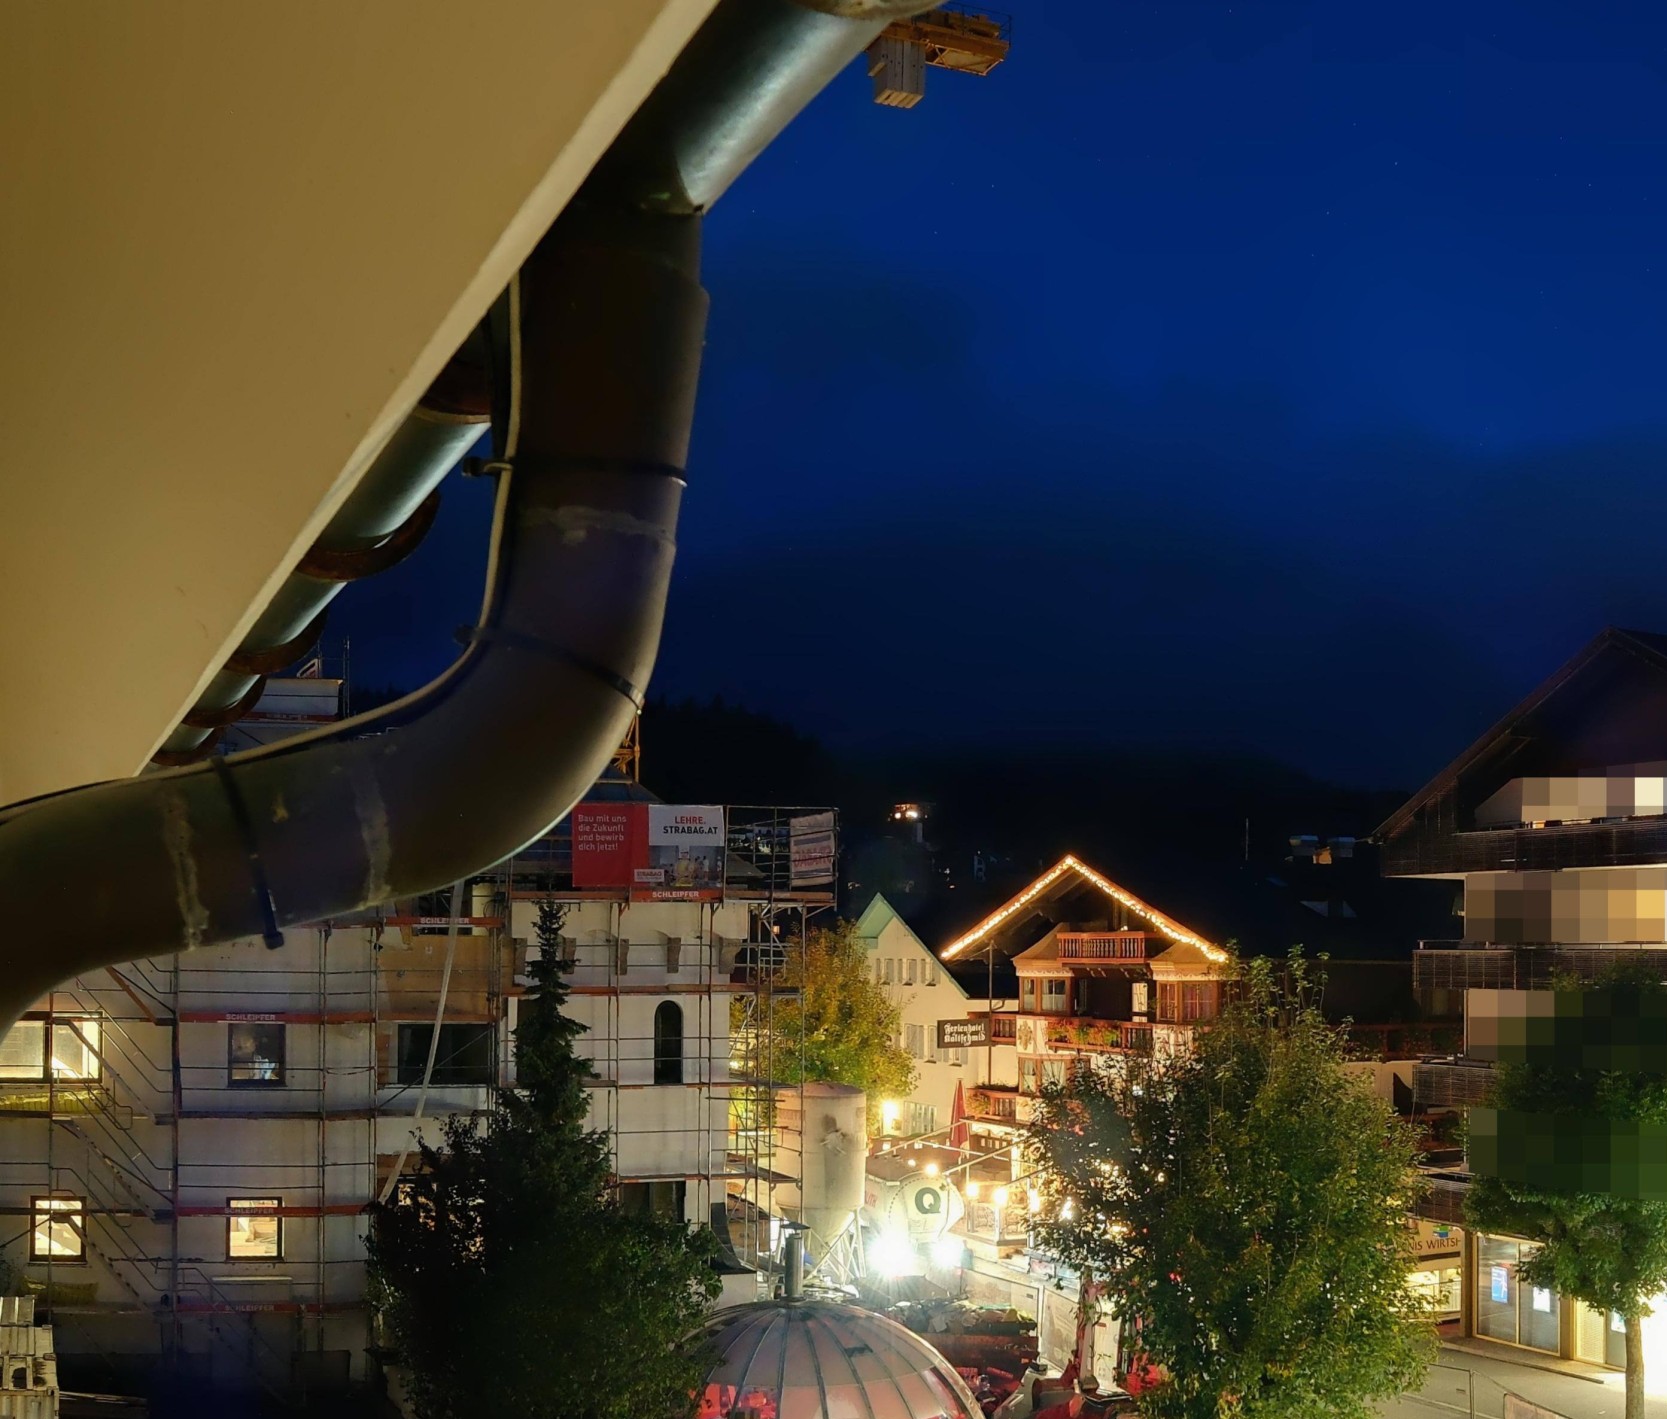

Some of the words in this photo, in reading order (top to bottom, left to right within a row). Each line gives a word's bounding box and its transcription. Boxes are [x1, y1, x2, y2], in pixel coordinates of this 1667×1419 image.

[578, 814, 595, 823] Bau
[597, 814, 609, 823] mit
[674, 816, 707, 825] LEHRE.
[578, 824, 591, 832] die
[593, 824, 625, 833] Zukunft
[663, 826, 718, 835] STRABAG.AT
[578, 833, 593, 841] und
[595, 833, 625, 841] bewirb
[578, 842, 595, 850] dich
[597, 842, 619, 852] jetzt!
[652, 890, 700, 898] SCHLEIPFER
[915, 1187, 941, 1214] Q
